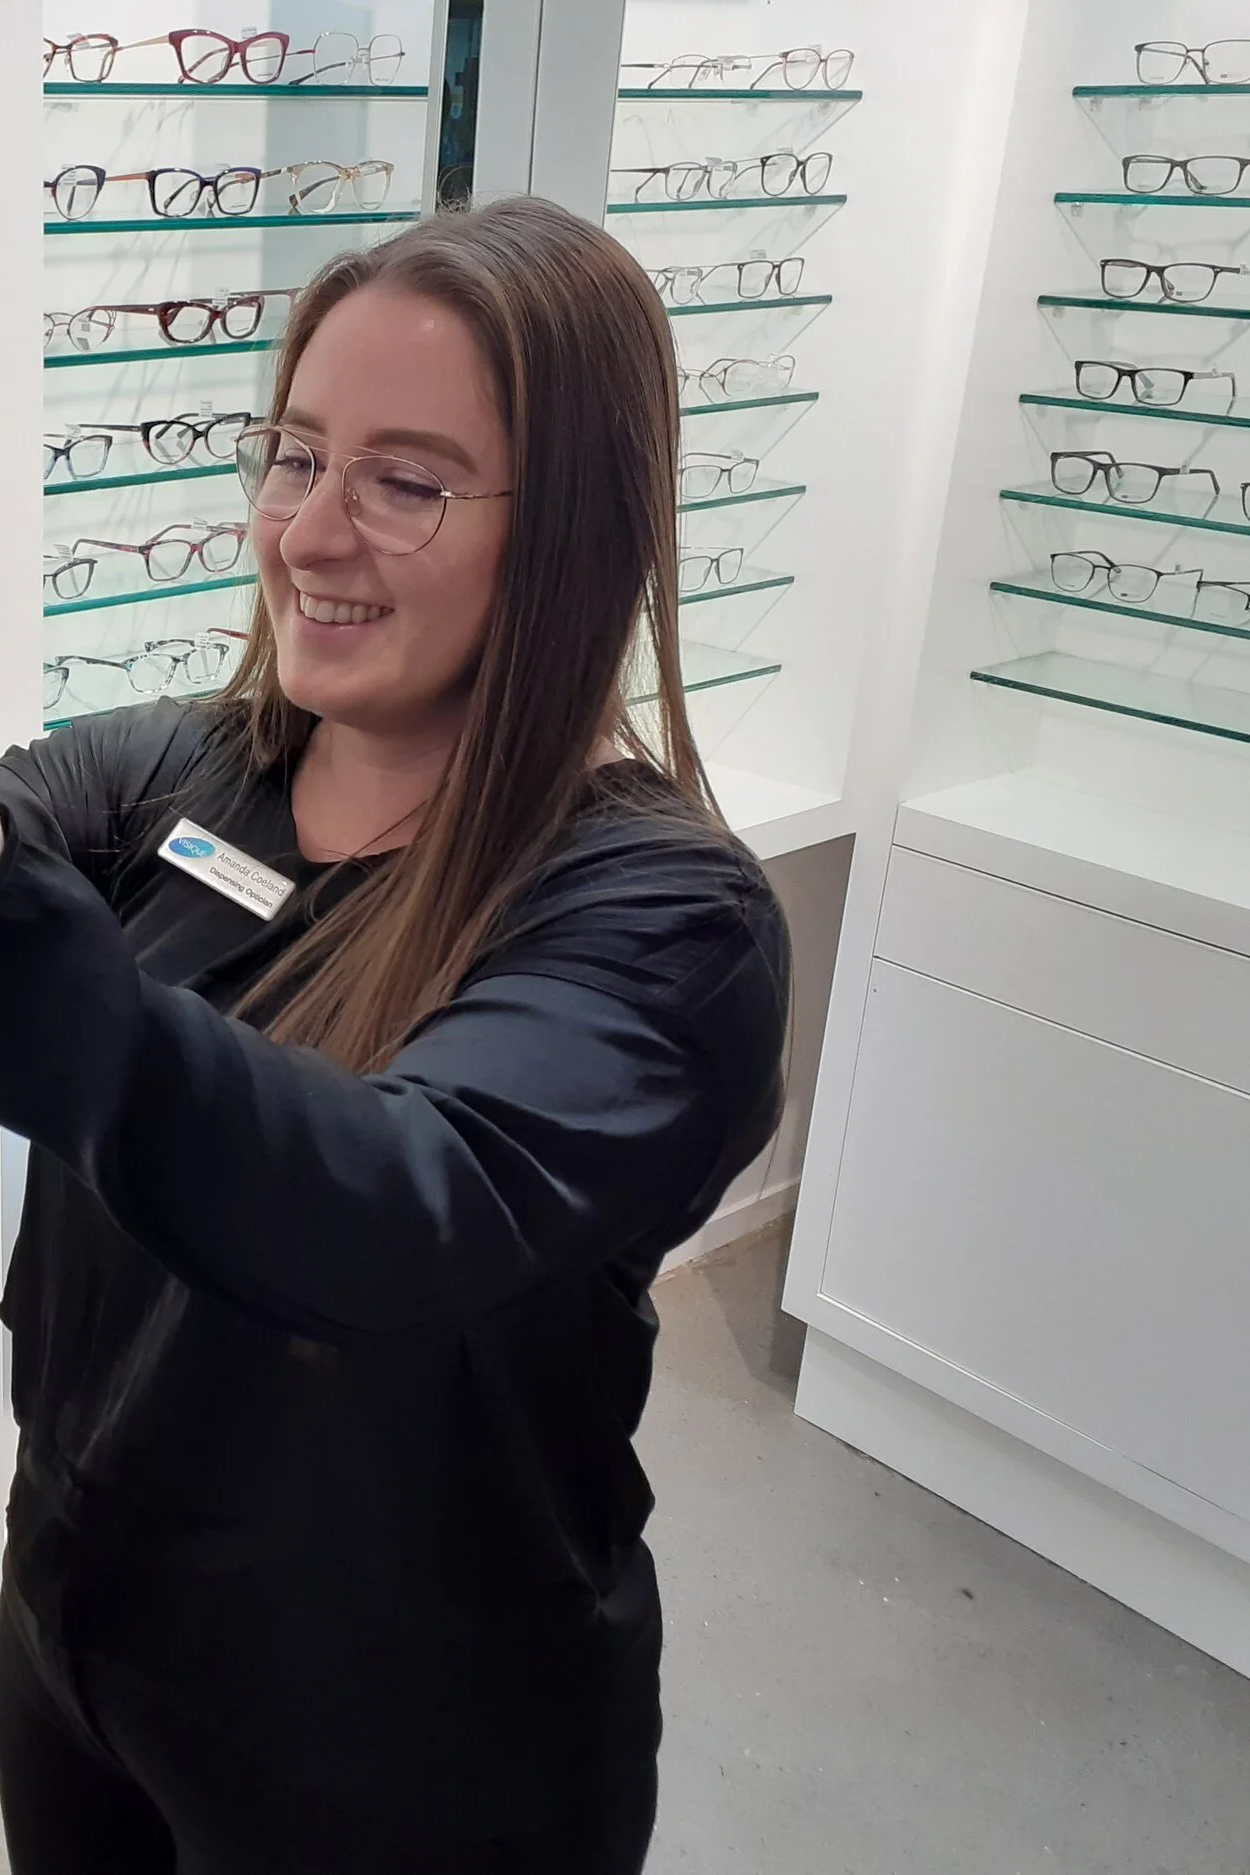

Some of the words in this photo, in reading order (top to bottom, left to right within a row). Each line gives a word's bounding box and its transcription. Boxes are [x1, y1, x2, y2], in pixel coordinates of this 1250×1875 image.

[210, 867, 245, 892] Dispensing
[246, 889, 273, 908] Optician
[217, 852, 250, 876] Amanda
[251, 872, 285, 897] Coeland
